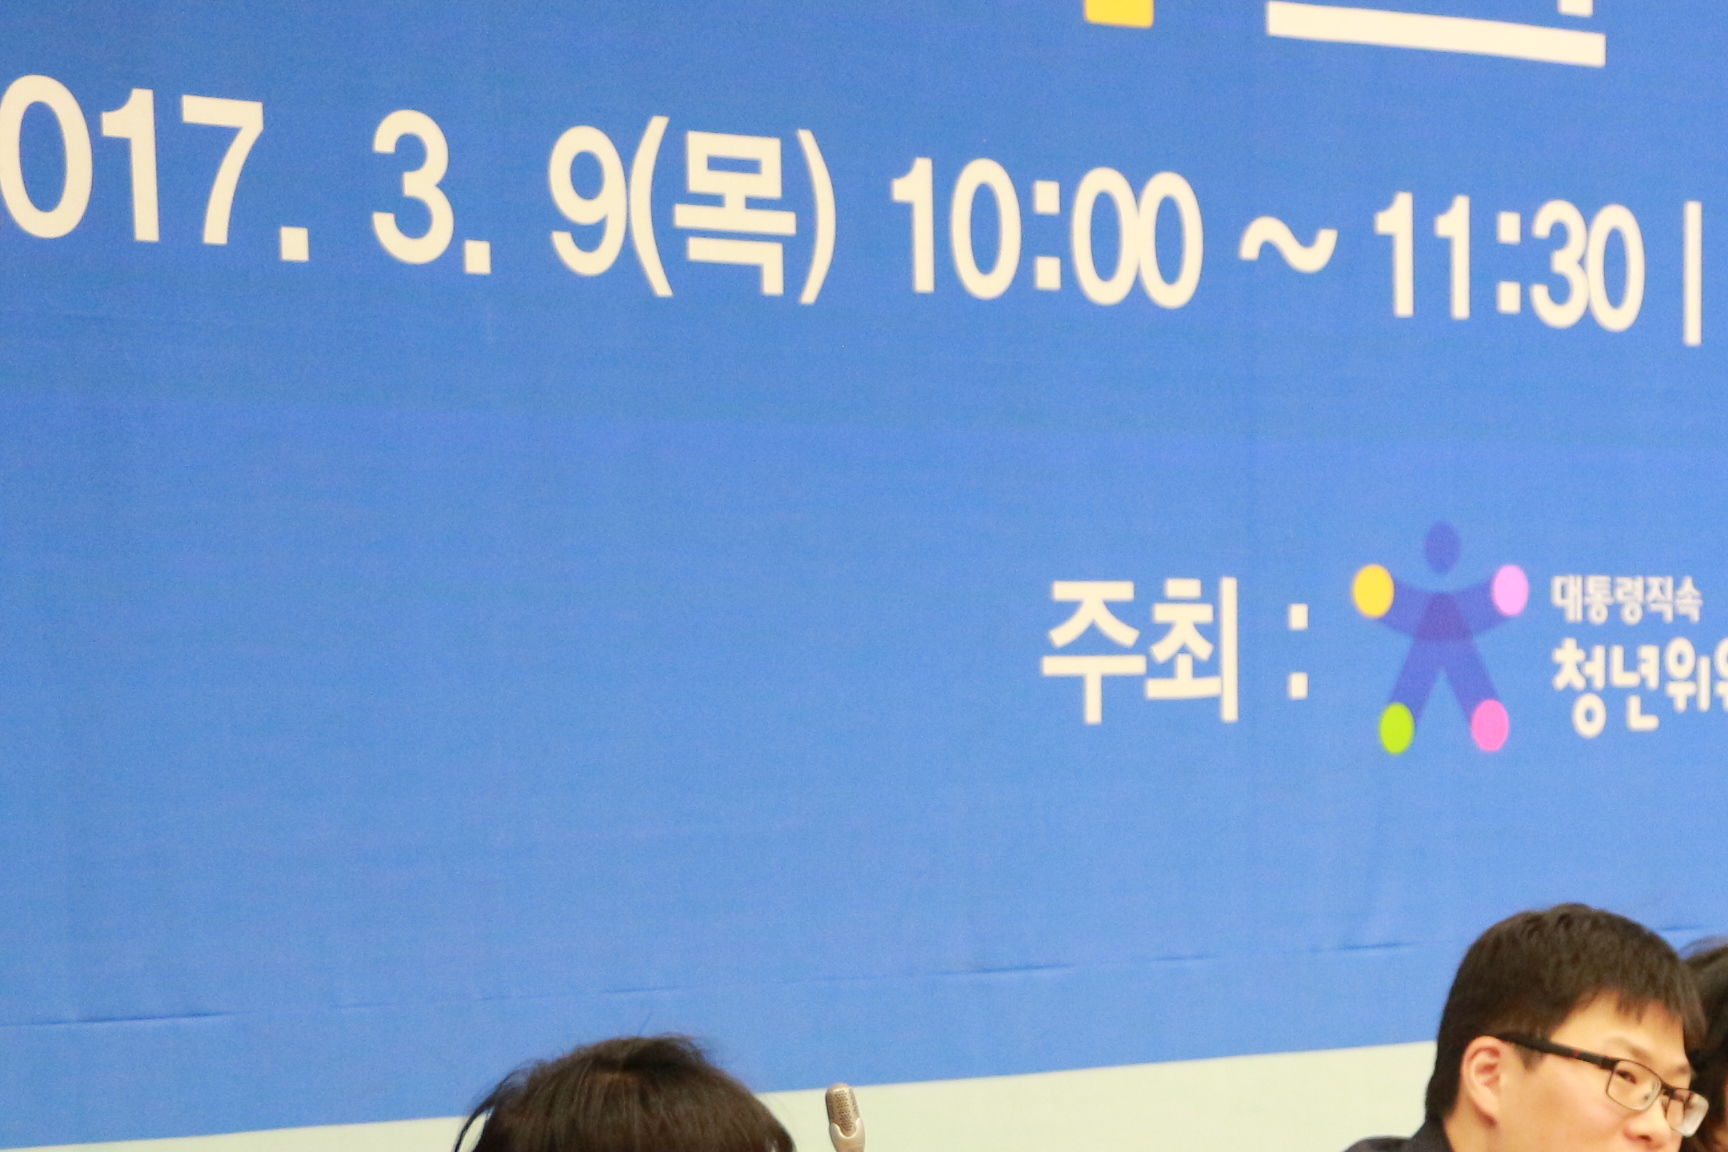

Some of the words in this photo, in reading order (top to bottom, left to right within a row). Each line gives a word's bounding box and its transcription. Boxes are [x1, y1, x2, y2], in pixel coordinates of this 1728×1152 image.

[372, 109, 491, 275] 3.
[548, 115, 836, 305] 9(목)
[891, 157, 1204, 309] 10:00
[1374, 191, 1646, 332] 11:30
[1551, 574, 1704, 625] 대통령직속
